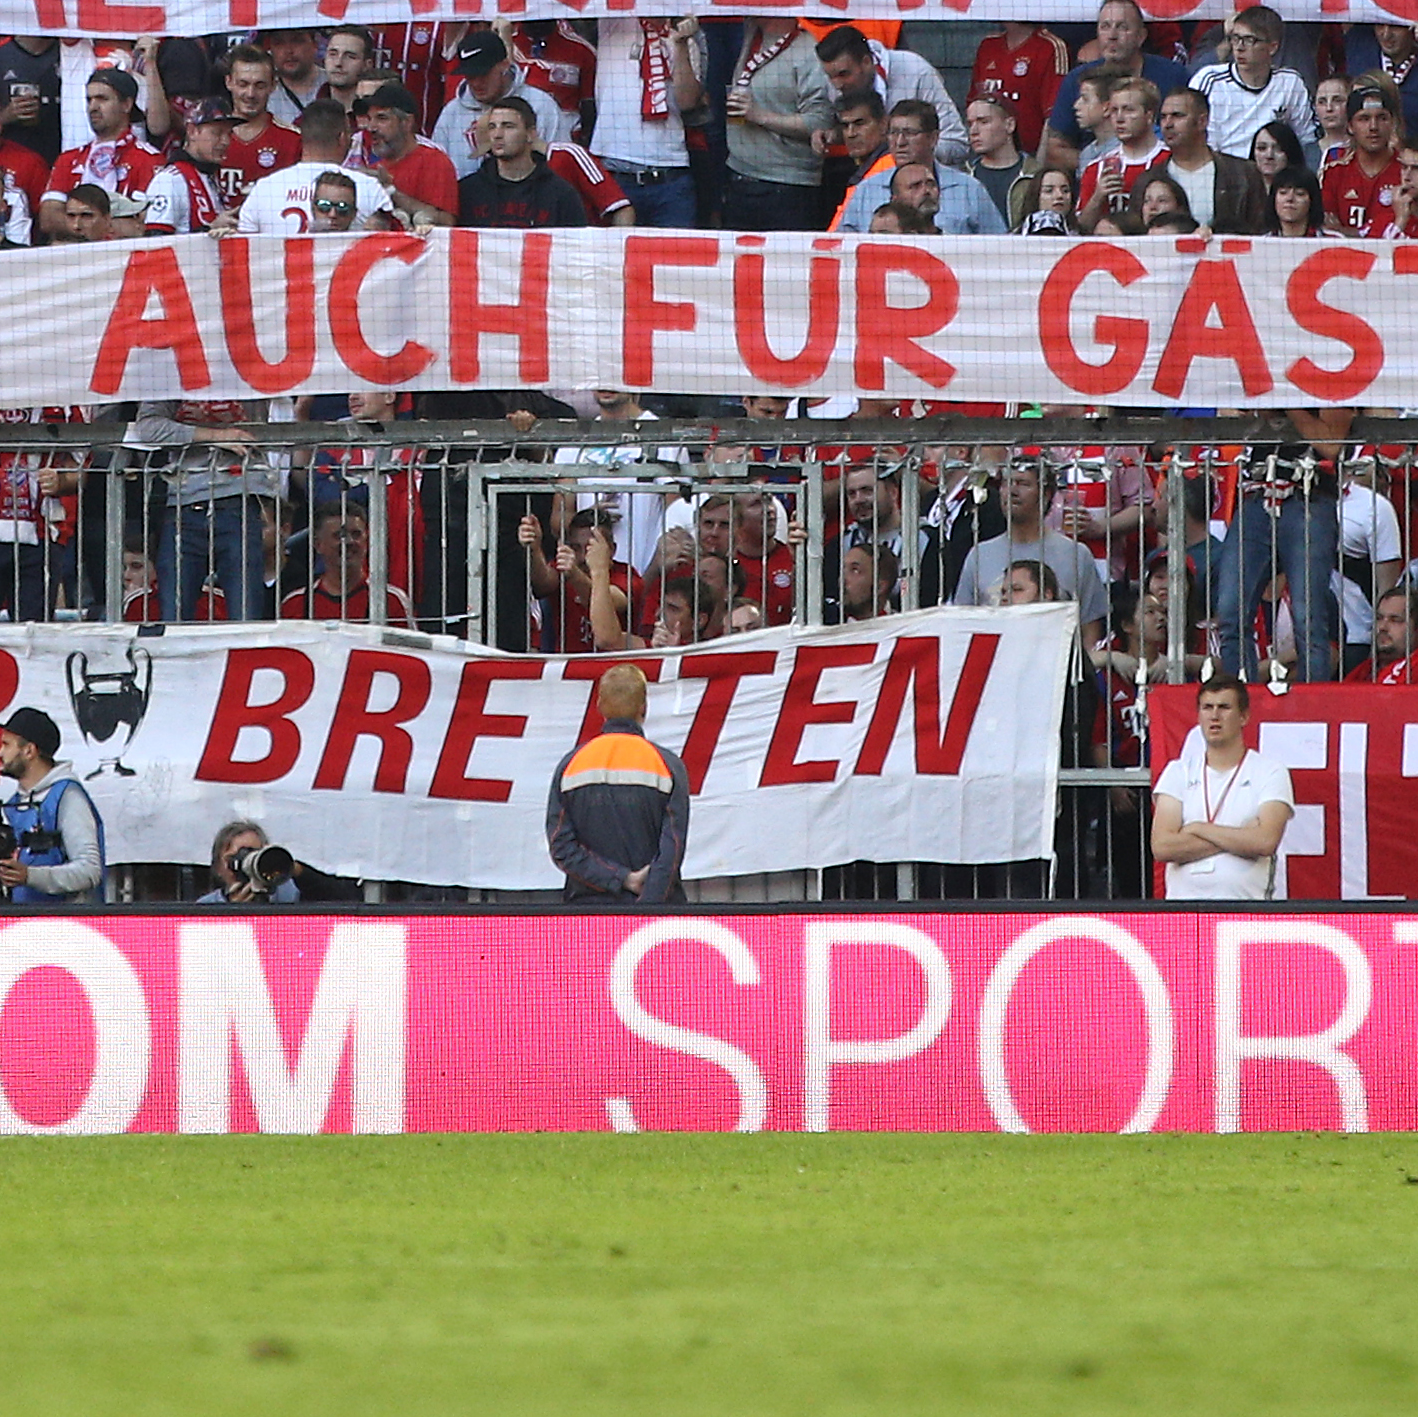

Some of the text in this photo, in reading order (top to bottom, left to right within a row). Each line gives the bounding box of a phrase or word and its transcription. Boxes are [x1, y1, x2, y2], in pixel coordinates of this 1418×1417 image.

[88, 229, 553, 394] AUCH
[622, 235, 959, 391] FÜR
[196, 633, 1001, 802] BRETTEN
